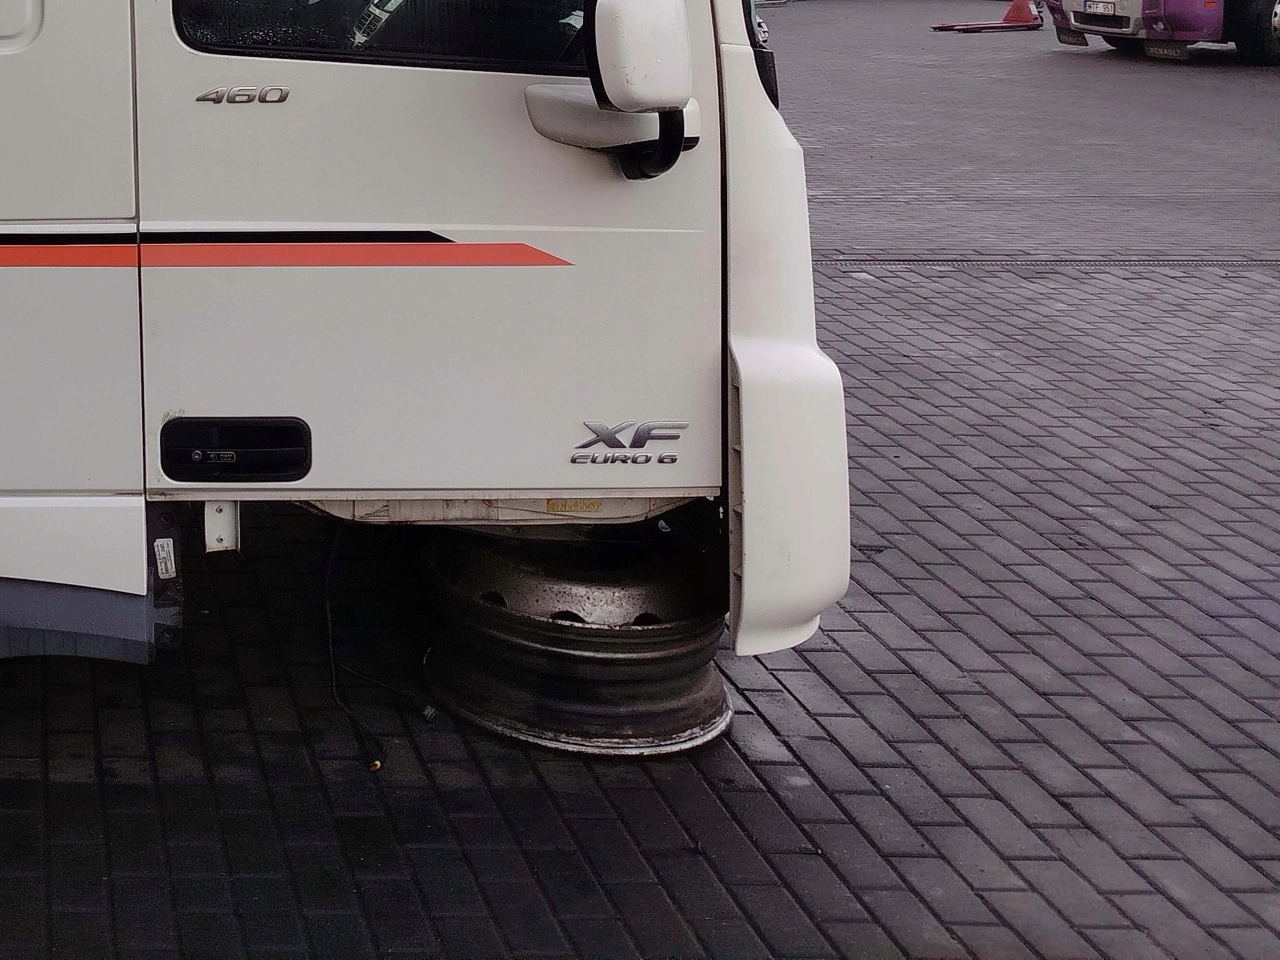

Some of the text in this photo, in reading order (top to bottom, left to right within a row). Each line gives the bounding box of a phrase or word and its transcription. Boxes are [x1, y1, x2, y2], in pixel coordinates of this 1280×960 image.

[1102, 3, 1113, 13] 951
[195, 86, 291, 104] 460
[574, 421, 690, 449] XF
[570, 451, 679, 465] EURO 6
